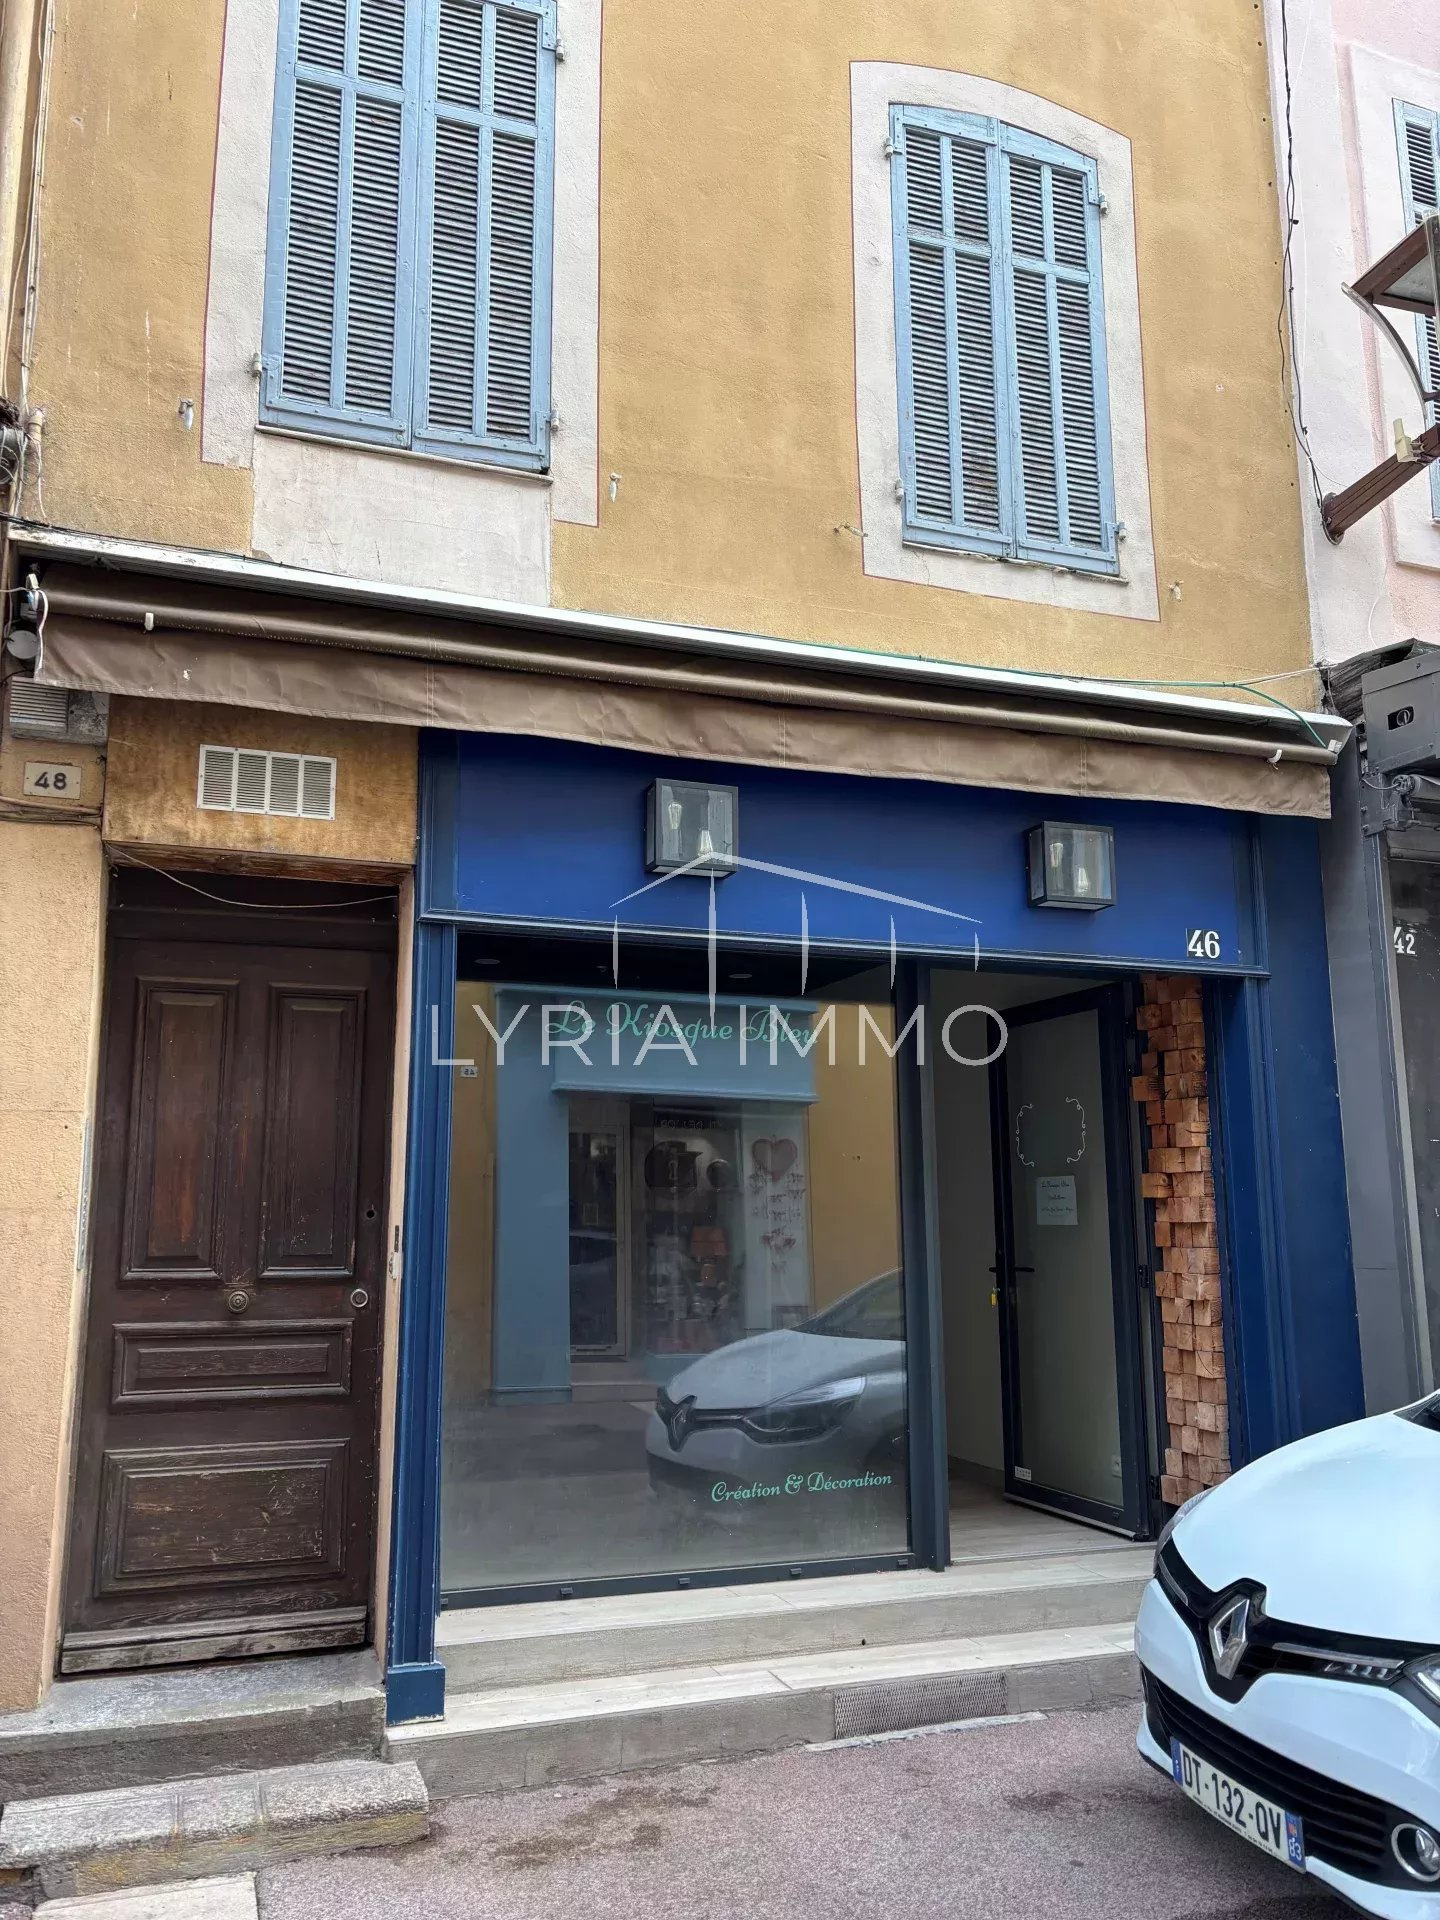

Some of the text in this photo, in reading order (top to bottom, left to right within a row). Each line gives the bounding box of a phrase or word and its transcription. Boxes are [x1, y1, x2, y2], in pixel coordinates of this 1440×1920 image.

[34, 771, 68, 790] 48
[1188, 929, 1221, 959] 46
[1393, 926, 1416, 955] 42
[545, 999, 595, 1034] Le
[606, 1001, 733, 1049] Kiosque
[711, 1471, 892, 1502] Création & Décoration
[1182, 1749, 1282, 1849] DT-132-QV
[1288, 1837, 1303, 1861] 83
